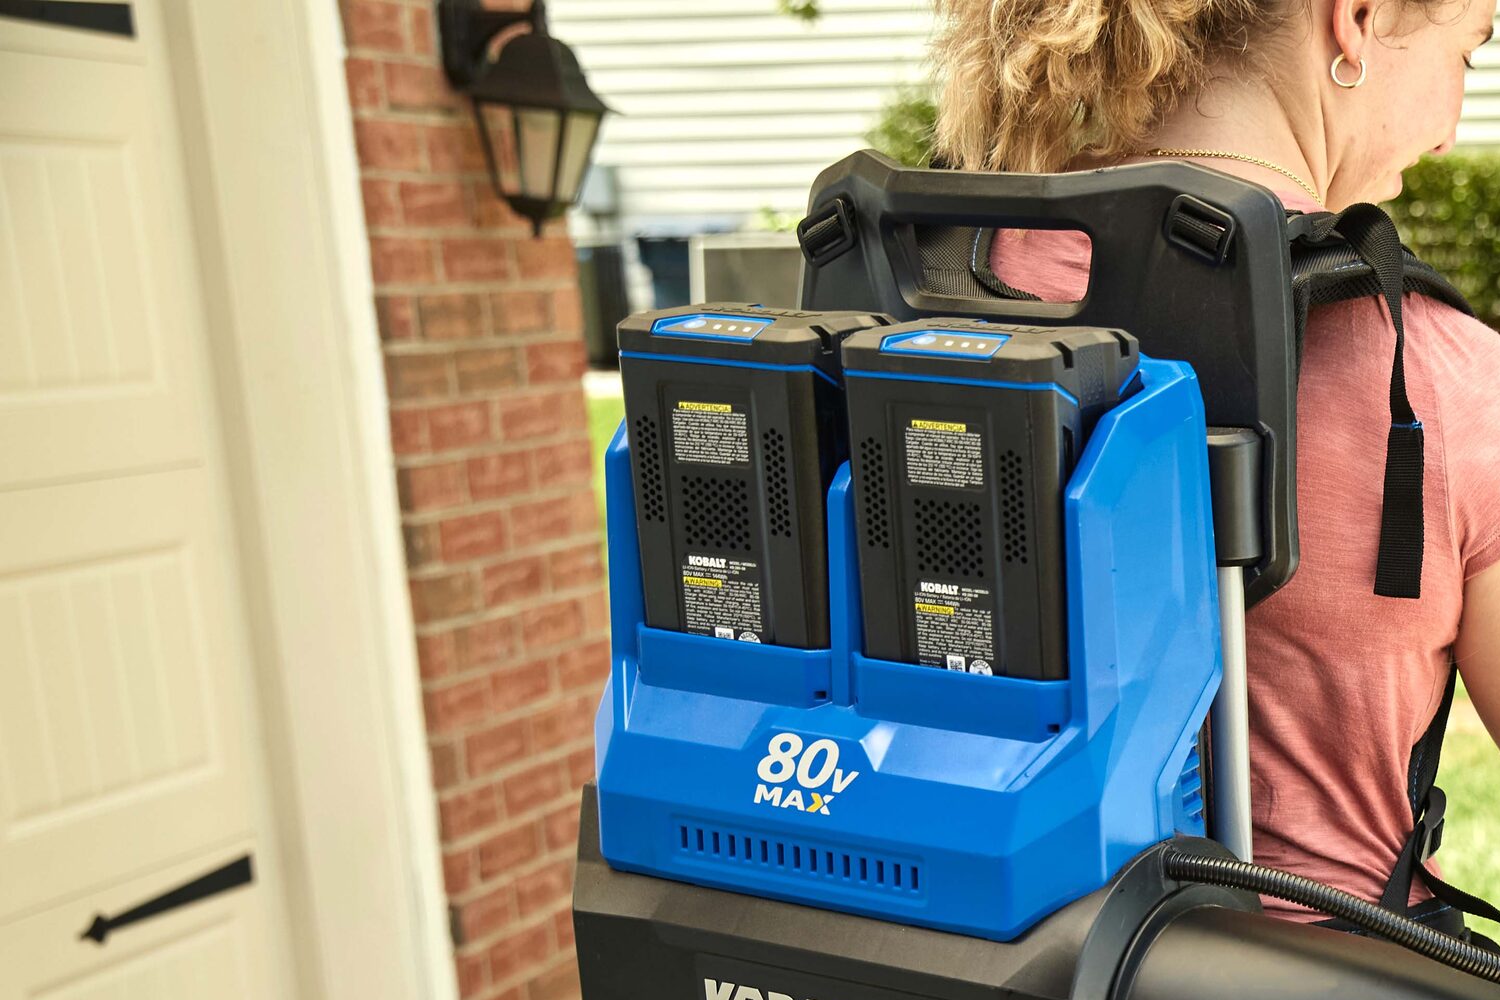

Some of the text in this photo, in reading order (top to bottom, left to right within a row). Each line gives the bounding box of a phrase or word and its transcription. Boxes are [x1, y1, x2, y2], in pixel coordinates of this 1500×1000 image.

[686, 403, 729, 411] ADVERTENCIA:
[919, 421, 964, 431] ADVERTENCIA:
[688, 555, 726, 568] KOBALT
[690, 578, 722, 587] WARNING:
[921, 582, 959, 595] KOBALT
[922, 604, 953, 614] WARNING:
[753, 784, 835, 815] MAX
